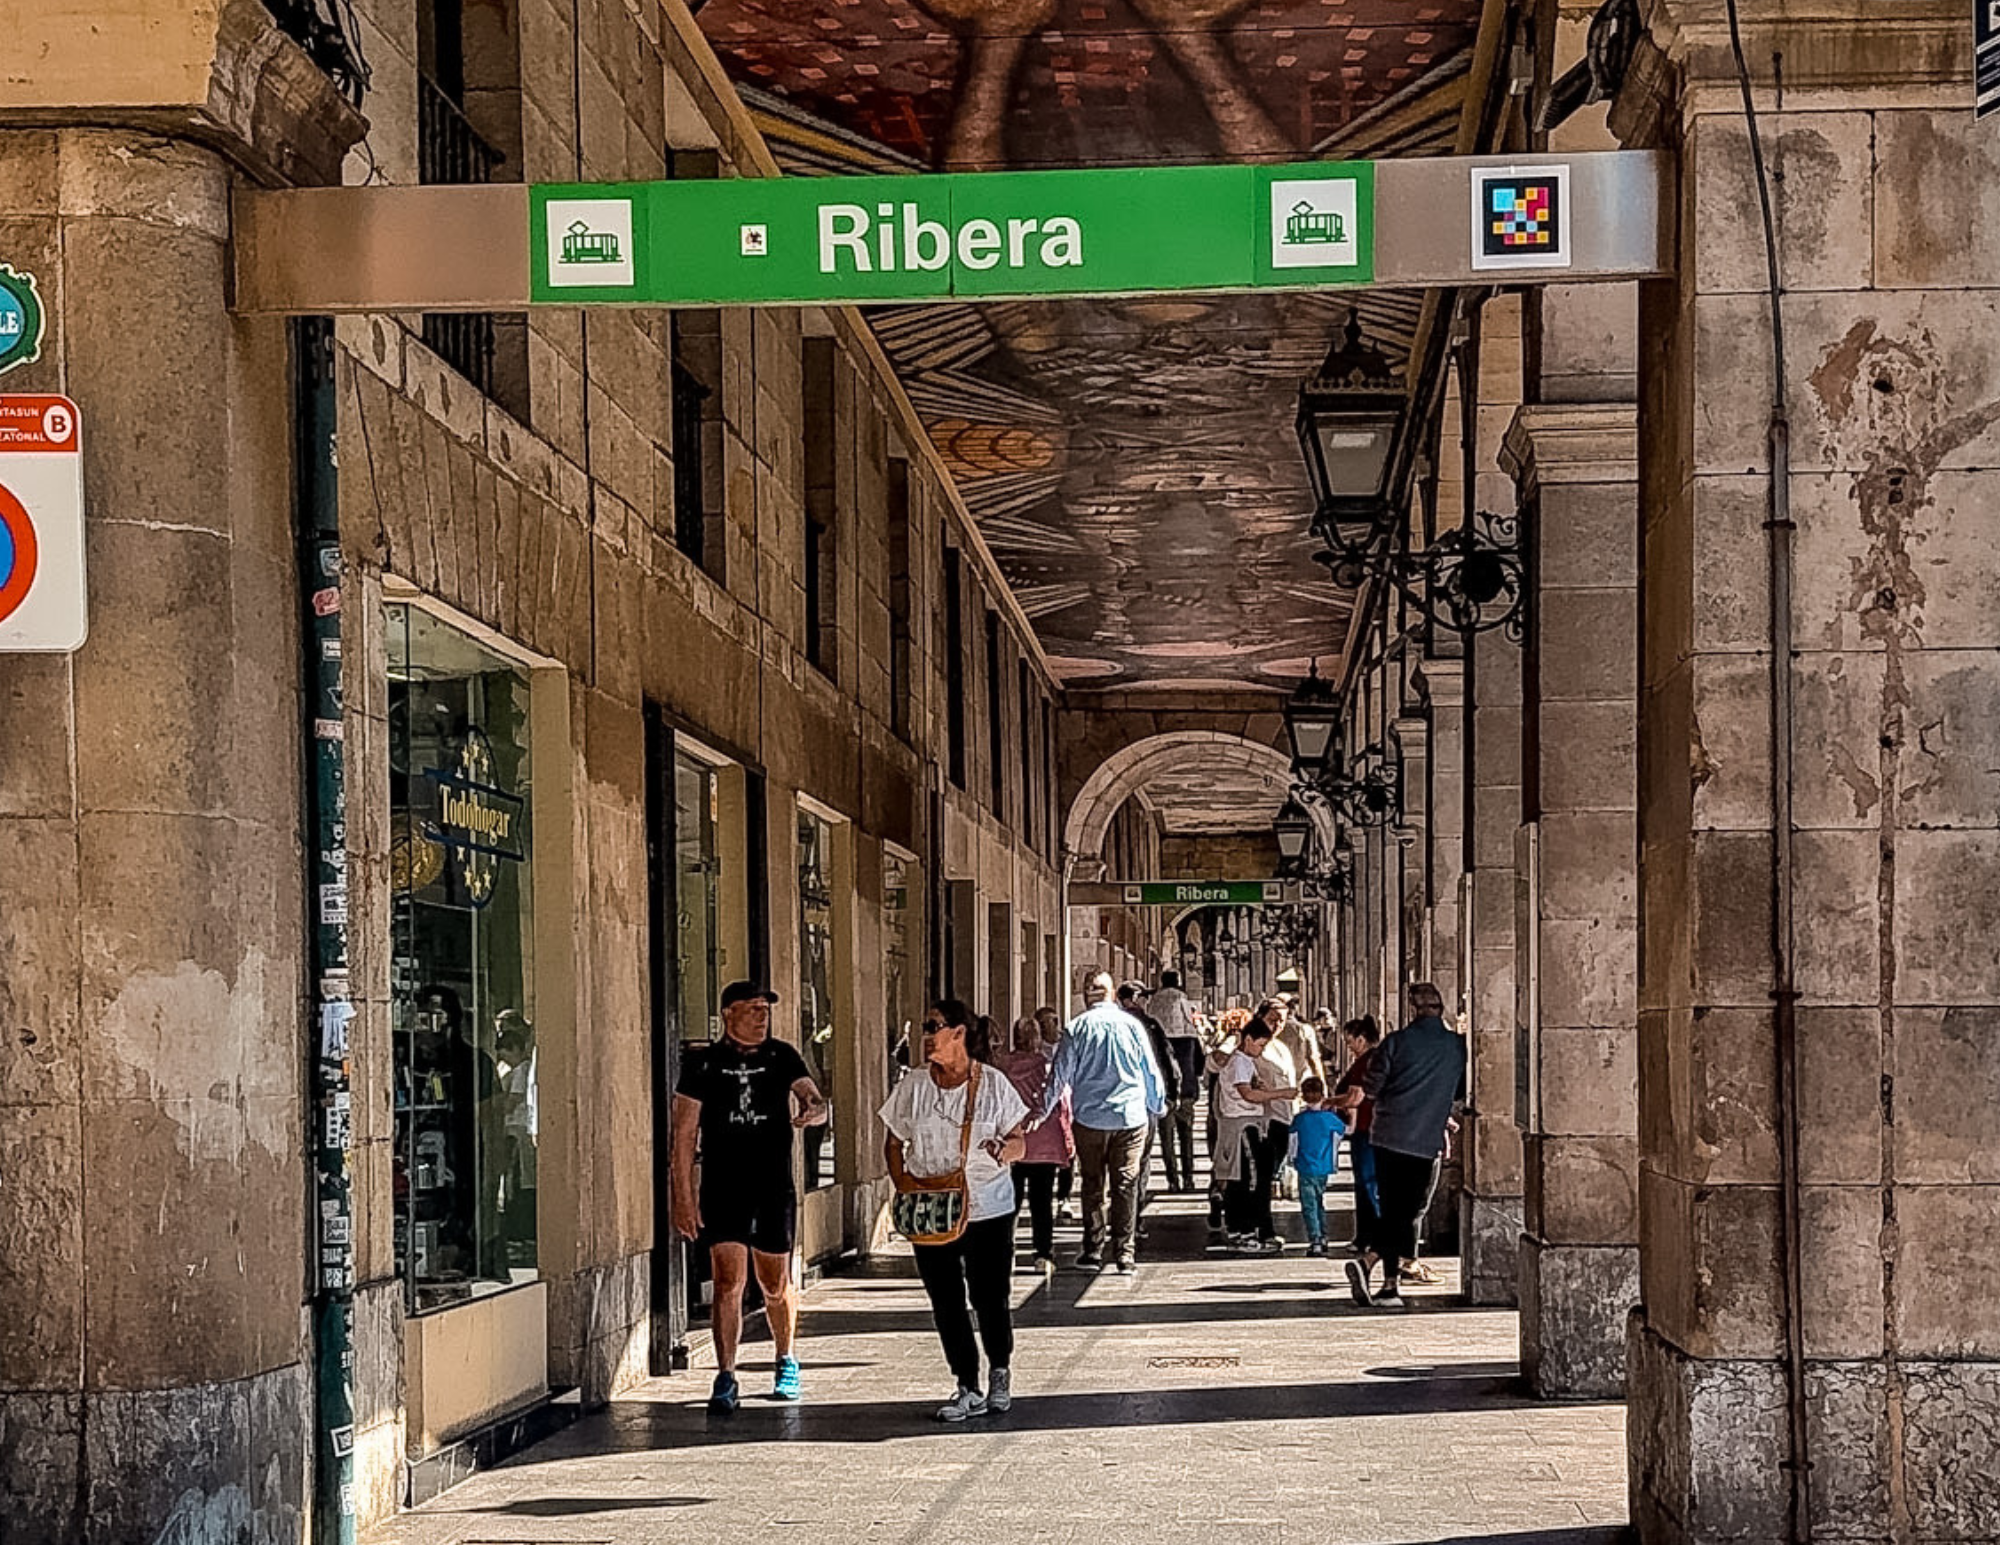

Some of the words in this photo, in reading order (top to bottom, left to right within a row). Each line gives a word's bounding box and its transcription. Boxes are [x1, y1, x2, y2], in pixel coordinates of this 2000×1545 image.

[817, 202, 1083, 274] Ribera
[51, 414, 66, 433] B
[439, 784, 510, 846] Todohogar
[1176, 885, 1229, 901] Ribera
